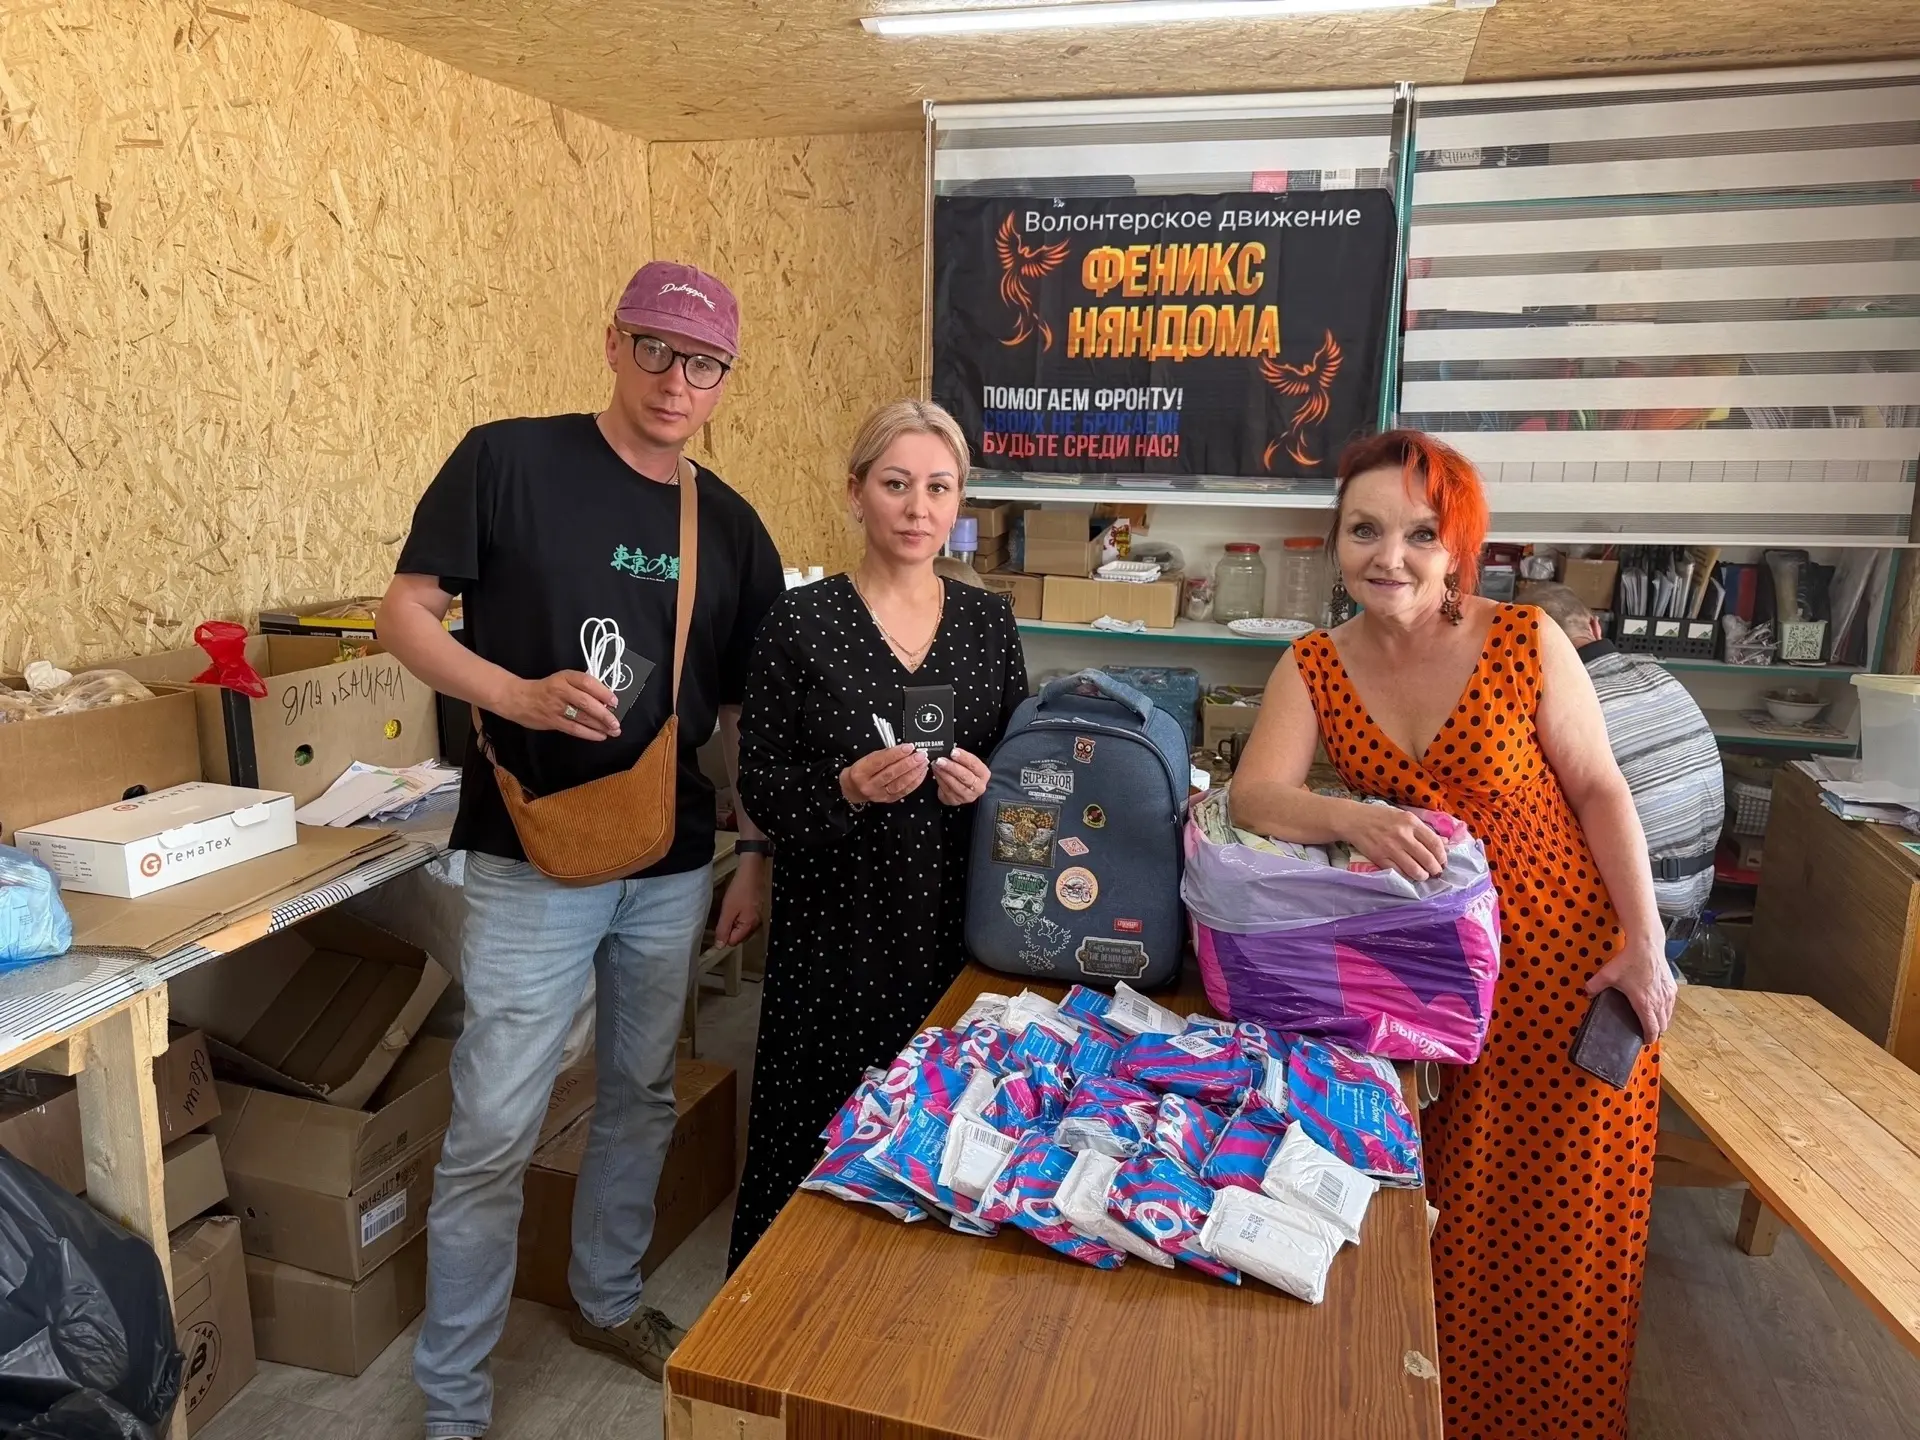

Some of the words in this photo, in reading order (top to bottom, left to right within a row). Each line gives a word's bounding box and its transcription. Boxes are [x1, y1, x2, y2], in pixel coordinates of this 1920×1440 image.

[1025, 209, 1212, 235] Волонтерское
[1218, 208, 1361, 231] движение
[1081, 242, 1267, 298] ФЕНИКС
[1067, 304, 1281, 362] НЯНДОМА
[983, 385, 1090, 411] ПОМОГАЕМ
[1094, 387, 1184, 411] ФРОНТУ!
[983, 410, 1046, 433] СВОИХ
[1052, 412, 1076, 434] НЕ
[1082, 412, 1181, 434] БРОСАЕМ!
[983, 431, 1059, 458] БУДЬТЕ
[1064, 434, 1132, 459] СРЕДИ
[1135, 435, 1180, 458] НАС!
[1022, 771, 1072, 790] SUPERIOR
